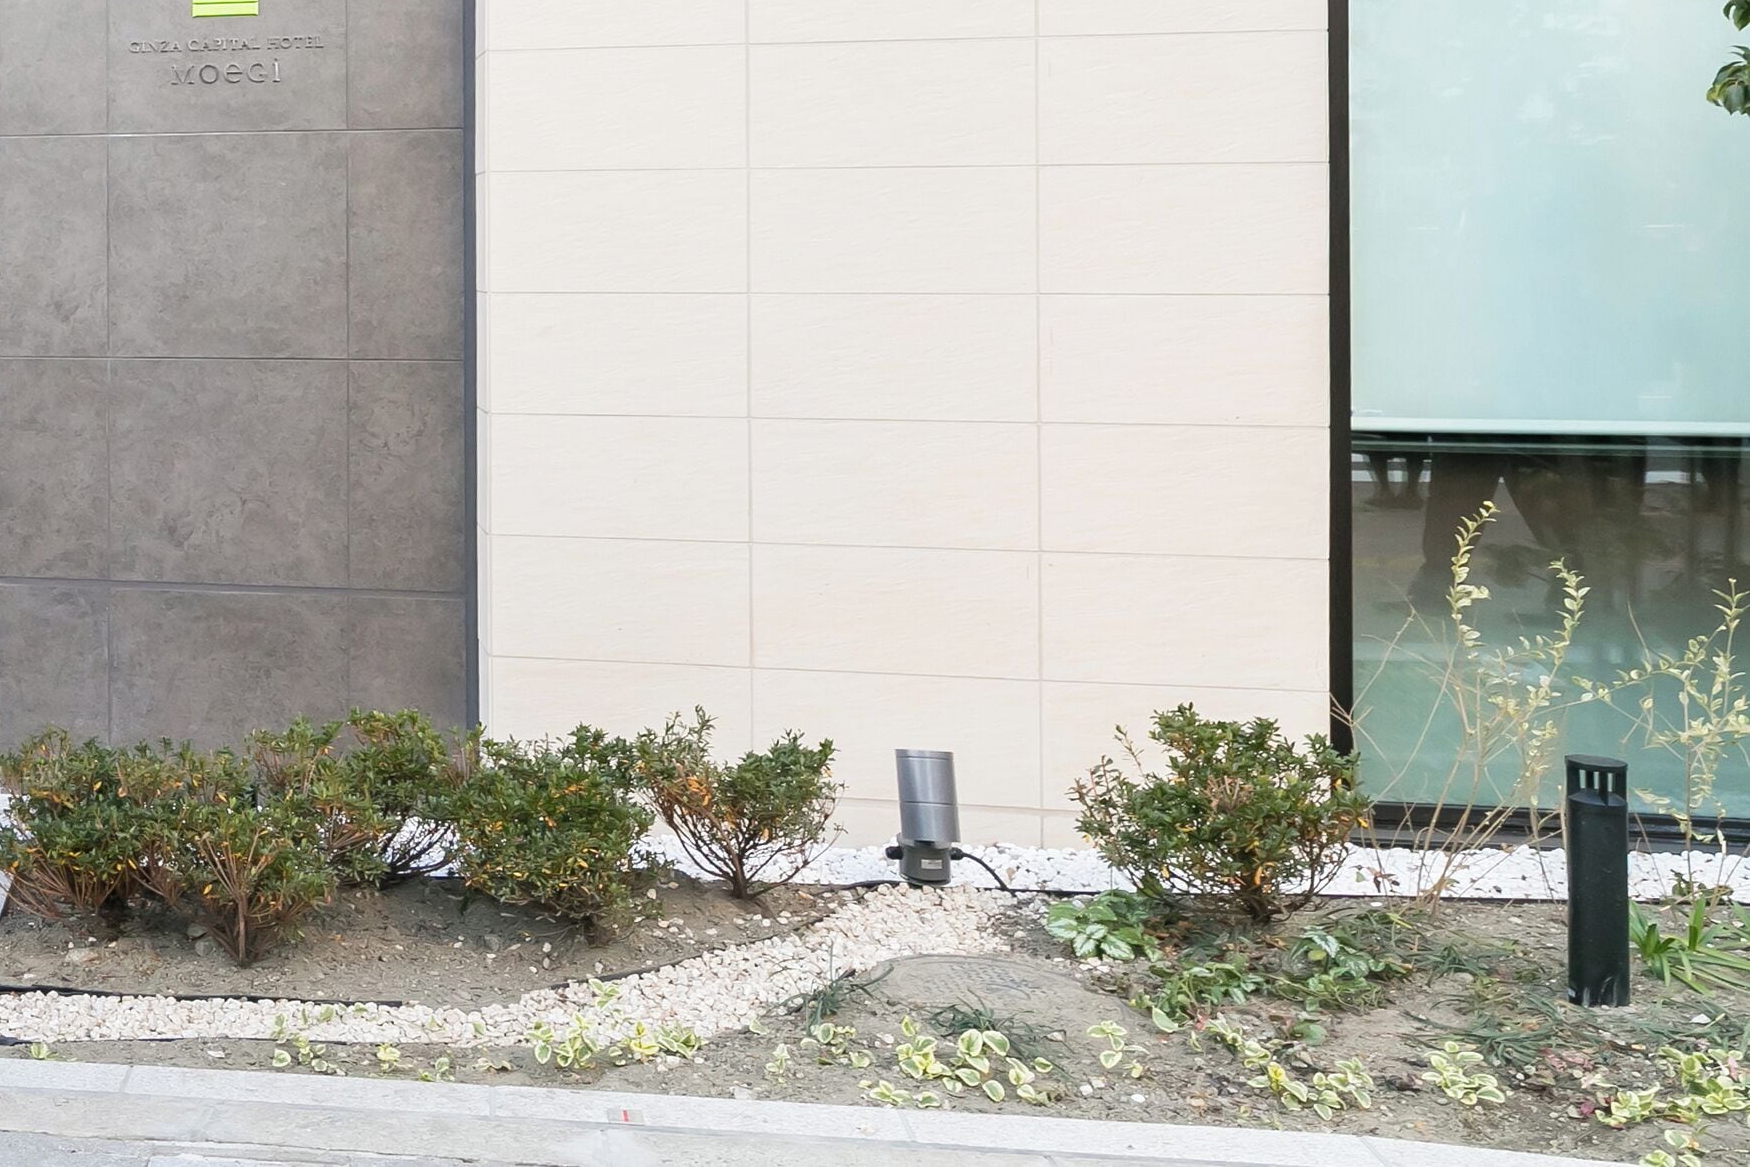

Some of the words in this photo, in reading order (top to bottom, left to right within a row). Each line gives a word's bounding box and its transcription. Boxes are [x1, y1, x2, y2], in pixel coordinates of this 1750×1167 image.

[129, 40, 182, 54] GINZA
[188, 37, 261, 52] CAPITAL
[266, 36, 325, 50] HOTEL
